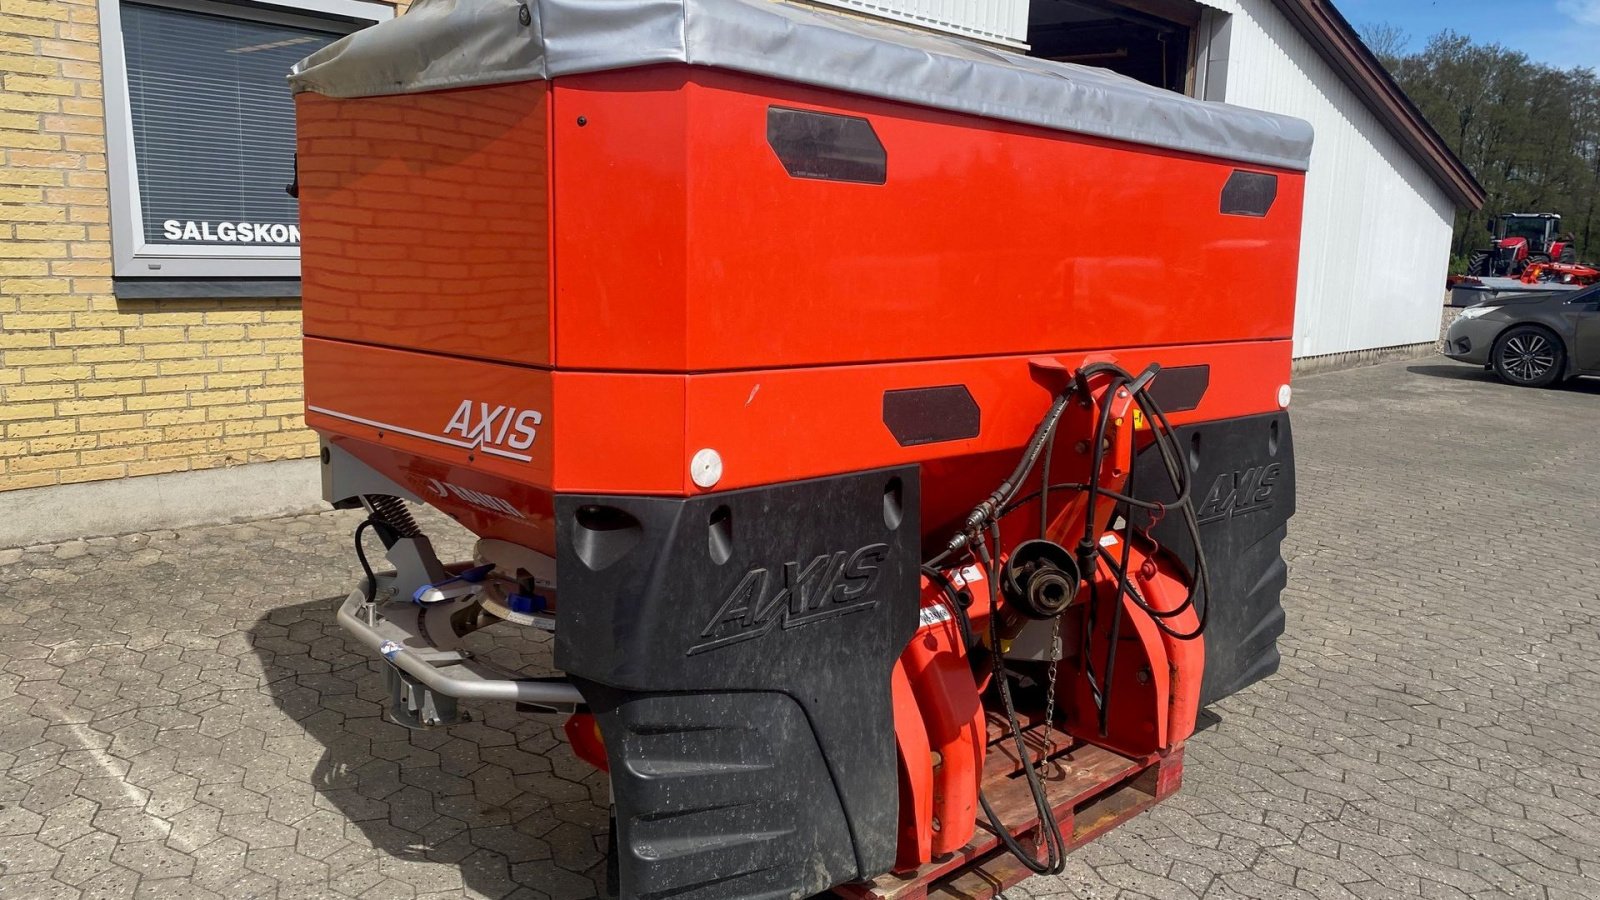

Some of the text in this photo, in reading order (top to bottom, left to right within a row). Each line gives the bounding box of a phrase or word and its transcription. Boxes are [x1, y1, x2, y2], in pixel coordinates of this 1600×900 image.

[443, 399, 542, 449] AXIS
[1197, 462, 1280, 516] AXIS
[701, 543, 888, 638] AXIS
